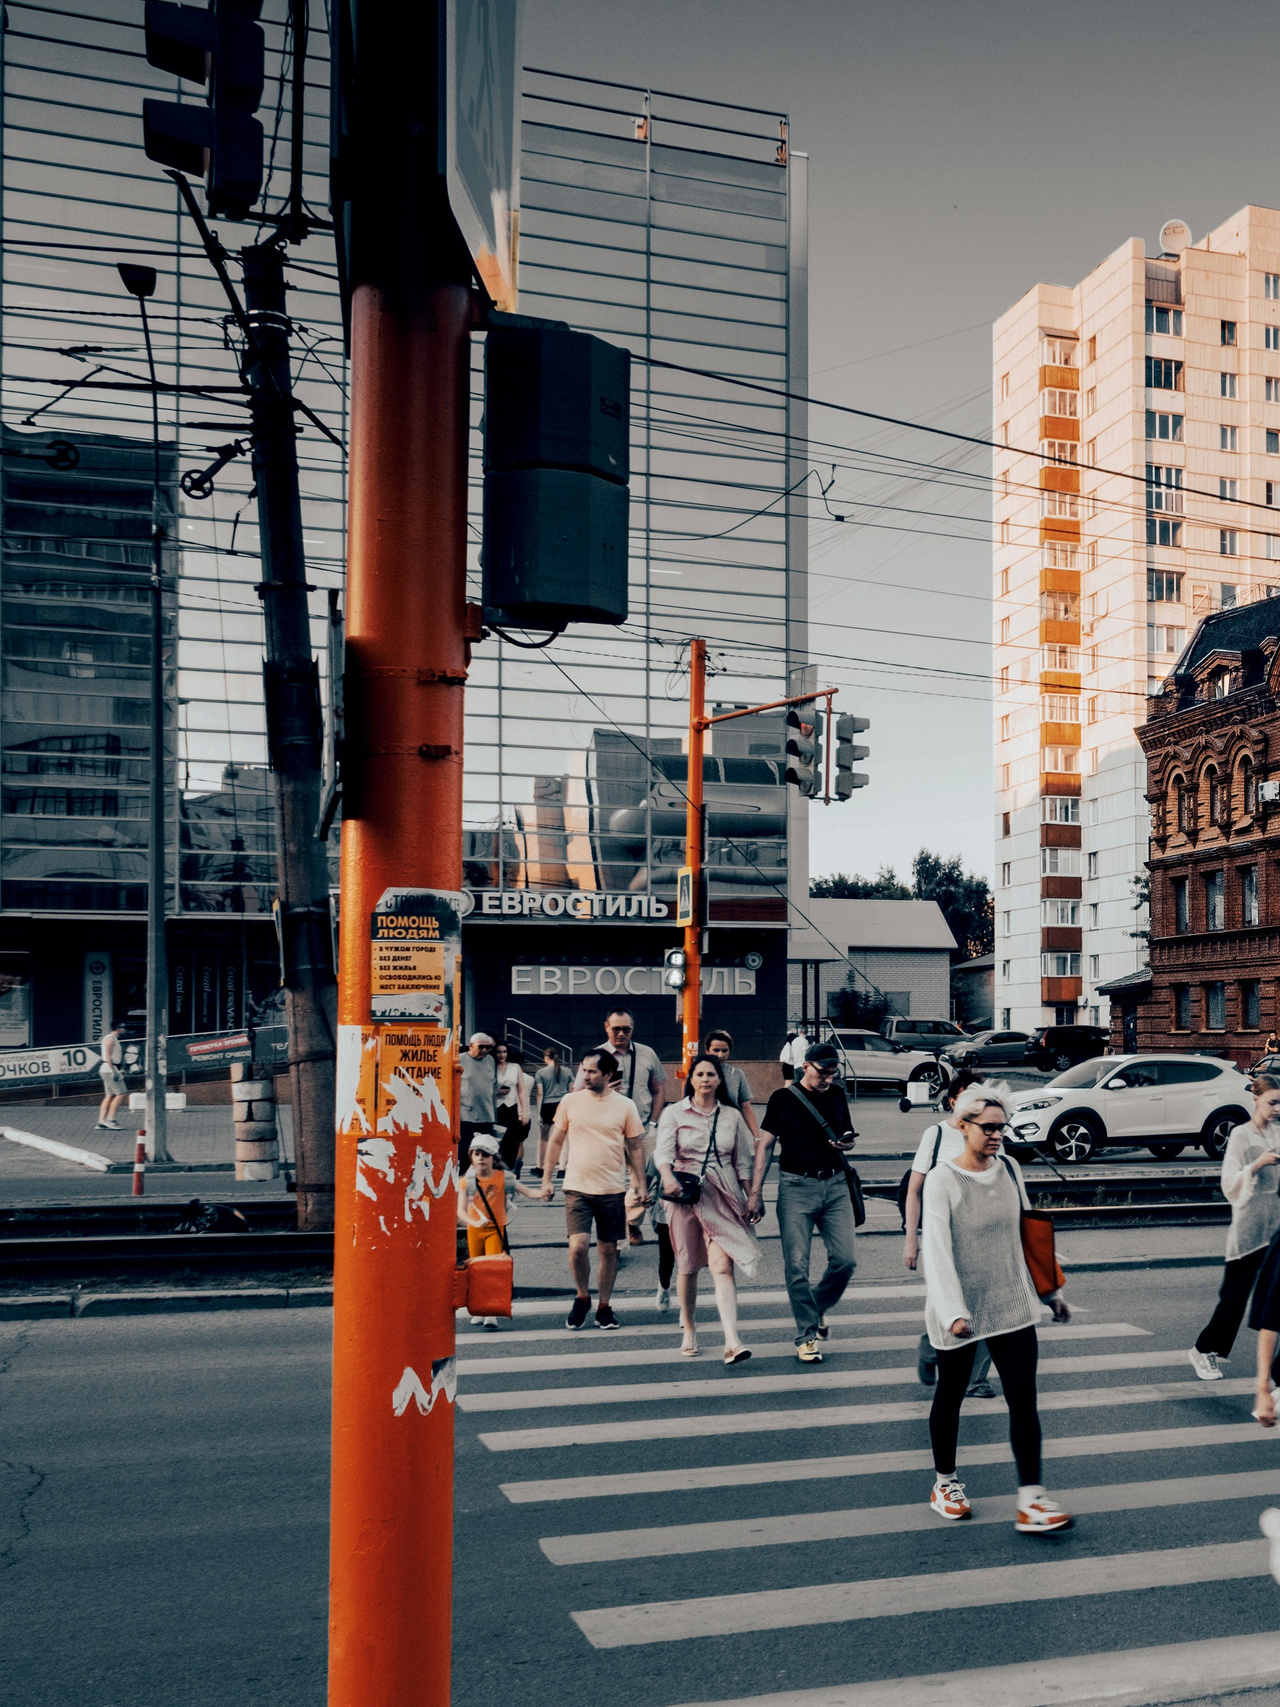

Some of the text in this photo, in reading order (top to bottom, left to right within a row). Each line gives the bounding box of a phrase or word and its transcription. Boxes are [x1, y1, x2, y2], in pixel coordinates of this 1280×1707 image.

[482, 892, 668, 918] ЕВРОСТИЛЬ
[377, 916, 440, 928] ПОМОЩЬ
[376, 928, 440, 939] ЛЮДЯМ
[635, 956, 740, 964] ОПКИ
[512, 966, 756, 994] ЕВРОСТЛЬ
[92, 980, 102, 1042] ЕВРОСТИЛЬ
[190, 1037, 248, 1052] ПРОВЕРКА ЗРЕНИЯ
[386, 1034, 422, 1046] ПОМОЩЬ
[62, 1049, 87, 1067] 10
[191, 1050, 252, 1062] РЕМОНТ ОЧКОВ
[400, 1050, 438, 1062] ЖИЛЬЕ
[394, 1066, 441, 1079] ПИТАНИЕ
